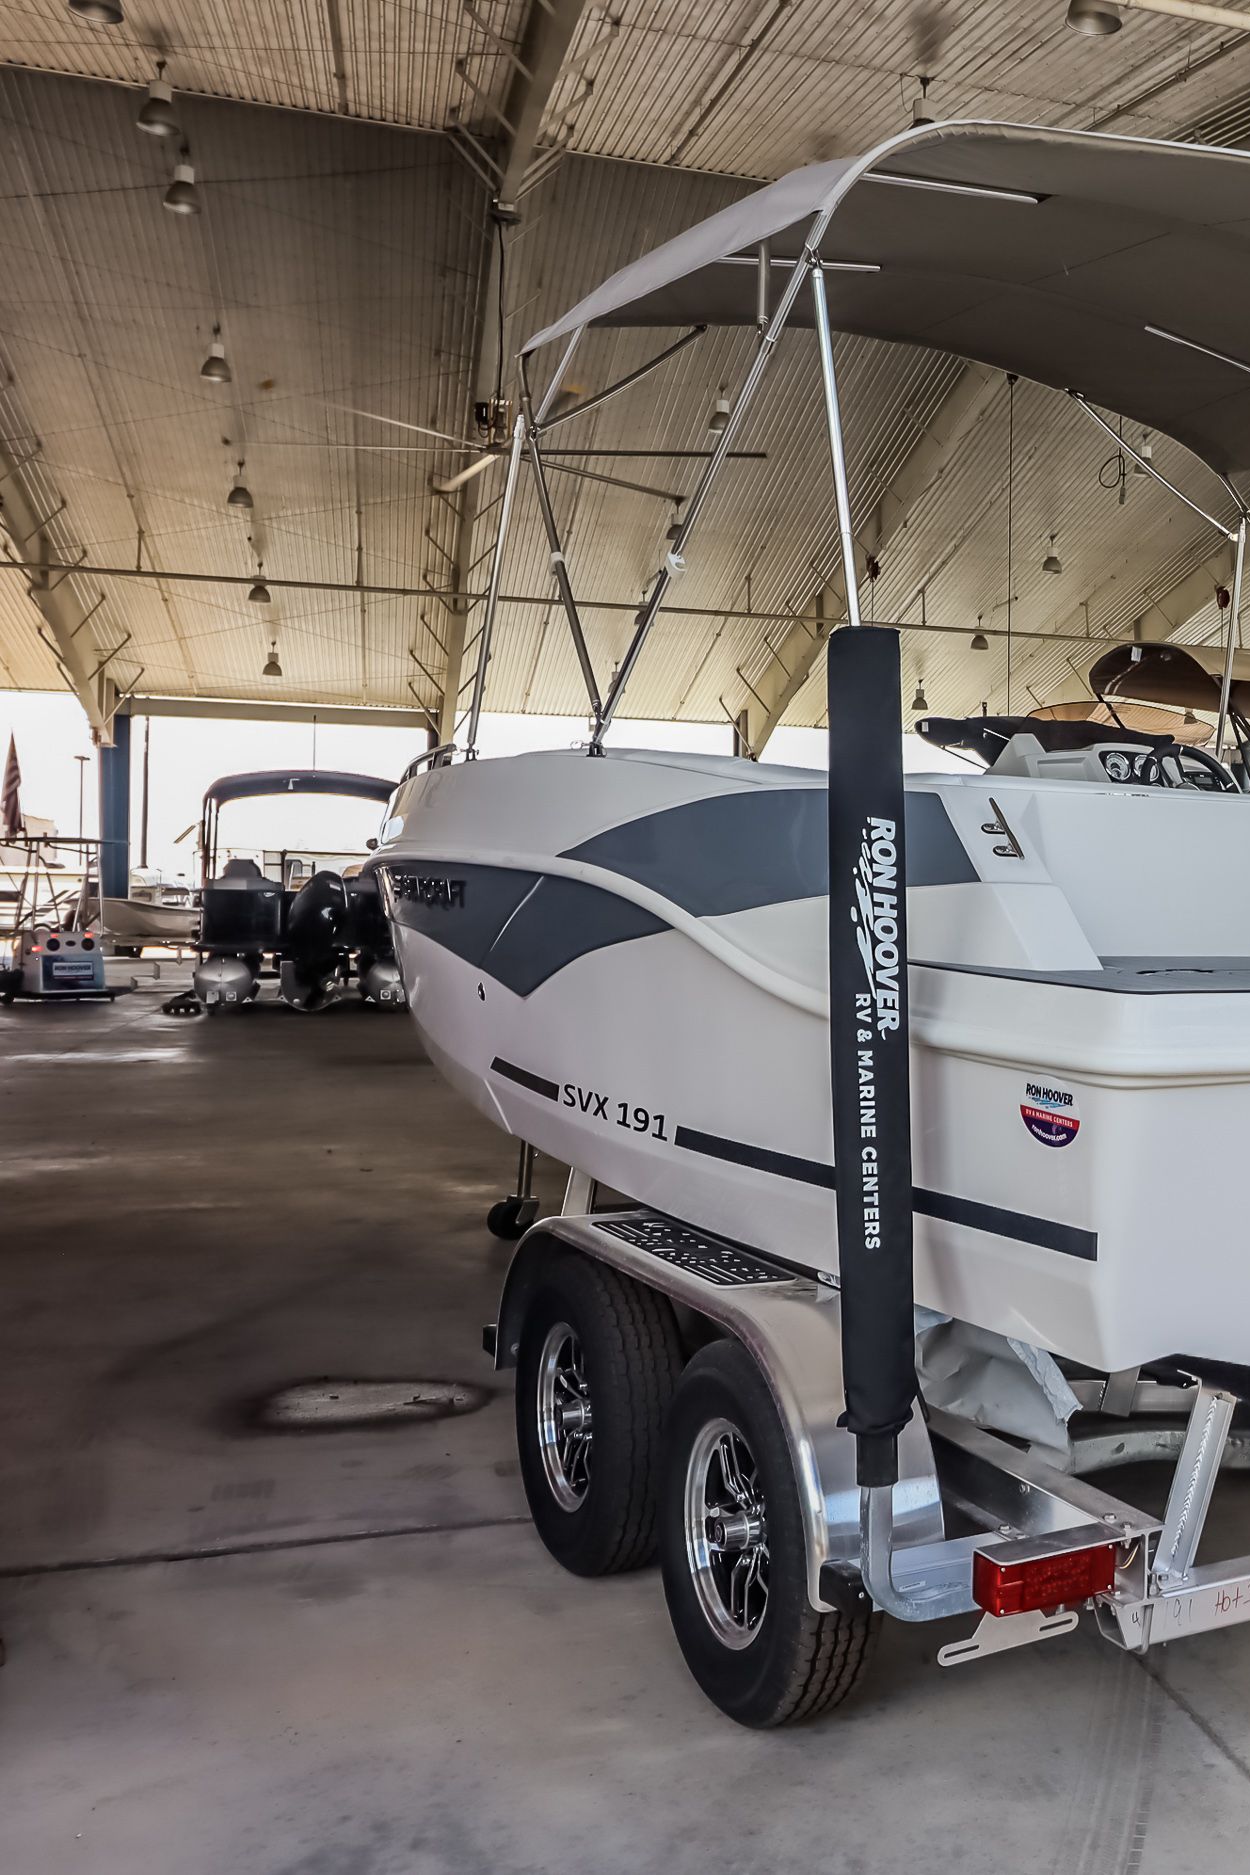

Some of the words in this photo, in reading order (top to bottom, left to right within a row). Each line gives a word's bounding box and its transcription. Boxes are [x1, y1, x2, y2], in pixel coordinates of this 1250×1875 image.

[870, 816, 898, 890] RON
[872, 892, 900, 1038] HOOVER
[855, 993, 873, 1023] RV
[856, 1028, 873, 1043] &
[562, 1083, 609, 1121] SVX
[616, 1101, 668, 1142] 191
[857, 1050, 877, 1138] MARINE
[1025, 1082, 1042, 1098] RON
[1042, 1087, 1074, 1107] HOOVER
[1036, 1111, 1053, 1122] MARINE
[1053, 1116, 1073, 1128] CENTERS
[861, 1146, 881, 1249] CENTERS
